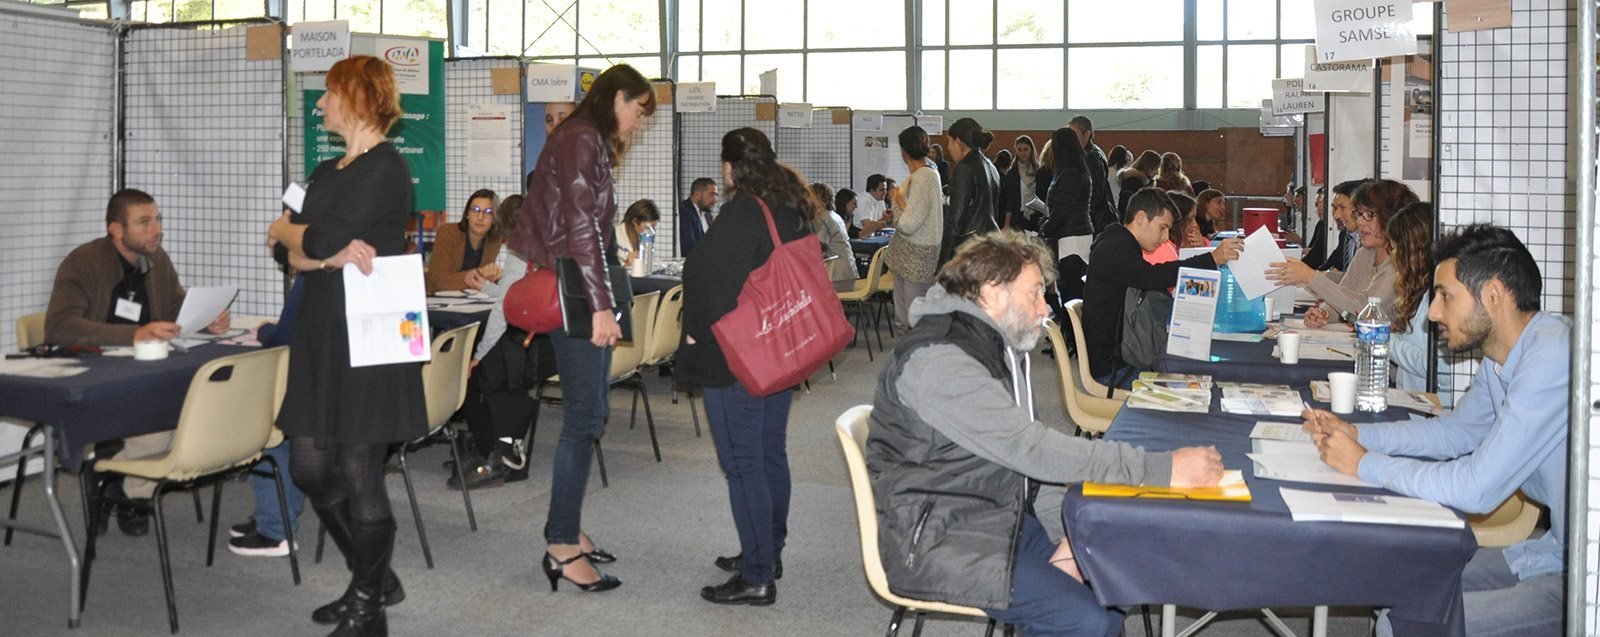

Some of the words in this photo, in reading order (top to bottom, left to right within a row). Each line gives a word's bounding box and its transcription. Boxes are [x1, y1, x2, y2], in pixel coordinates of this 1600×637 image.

[1331, 4, 1396, 23] GROUPE
[300, 31, 337, 42] MAISON
[1338, 26, 1392, 44] SAMSE
[293, 47, 345, 59] PORTELADA
[1324, 52, 1336, 61] 17
[1309, 62, 1368, 72] CASTORAMA
[531, 78, 549, 87] CMA
[550, 77, 569, 87] Isère
[1284, 91, 1311, 99] RALPH
[1282, 101, 1315, 110] LAUREN
[316, 144, 329, 153] 250
